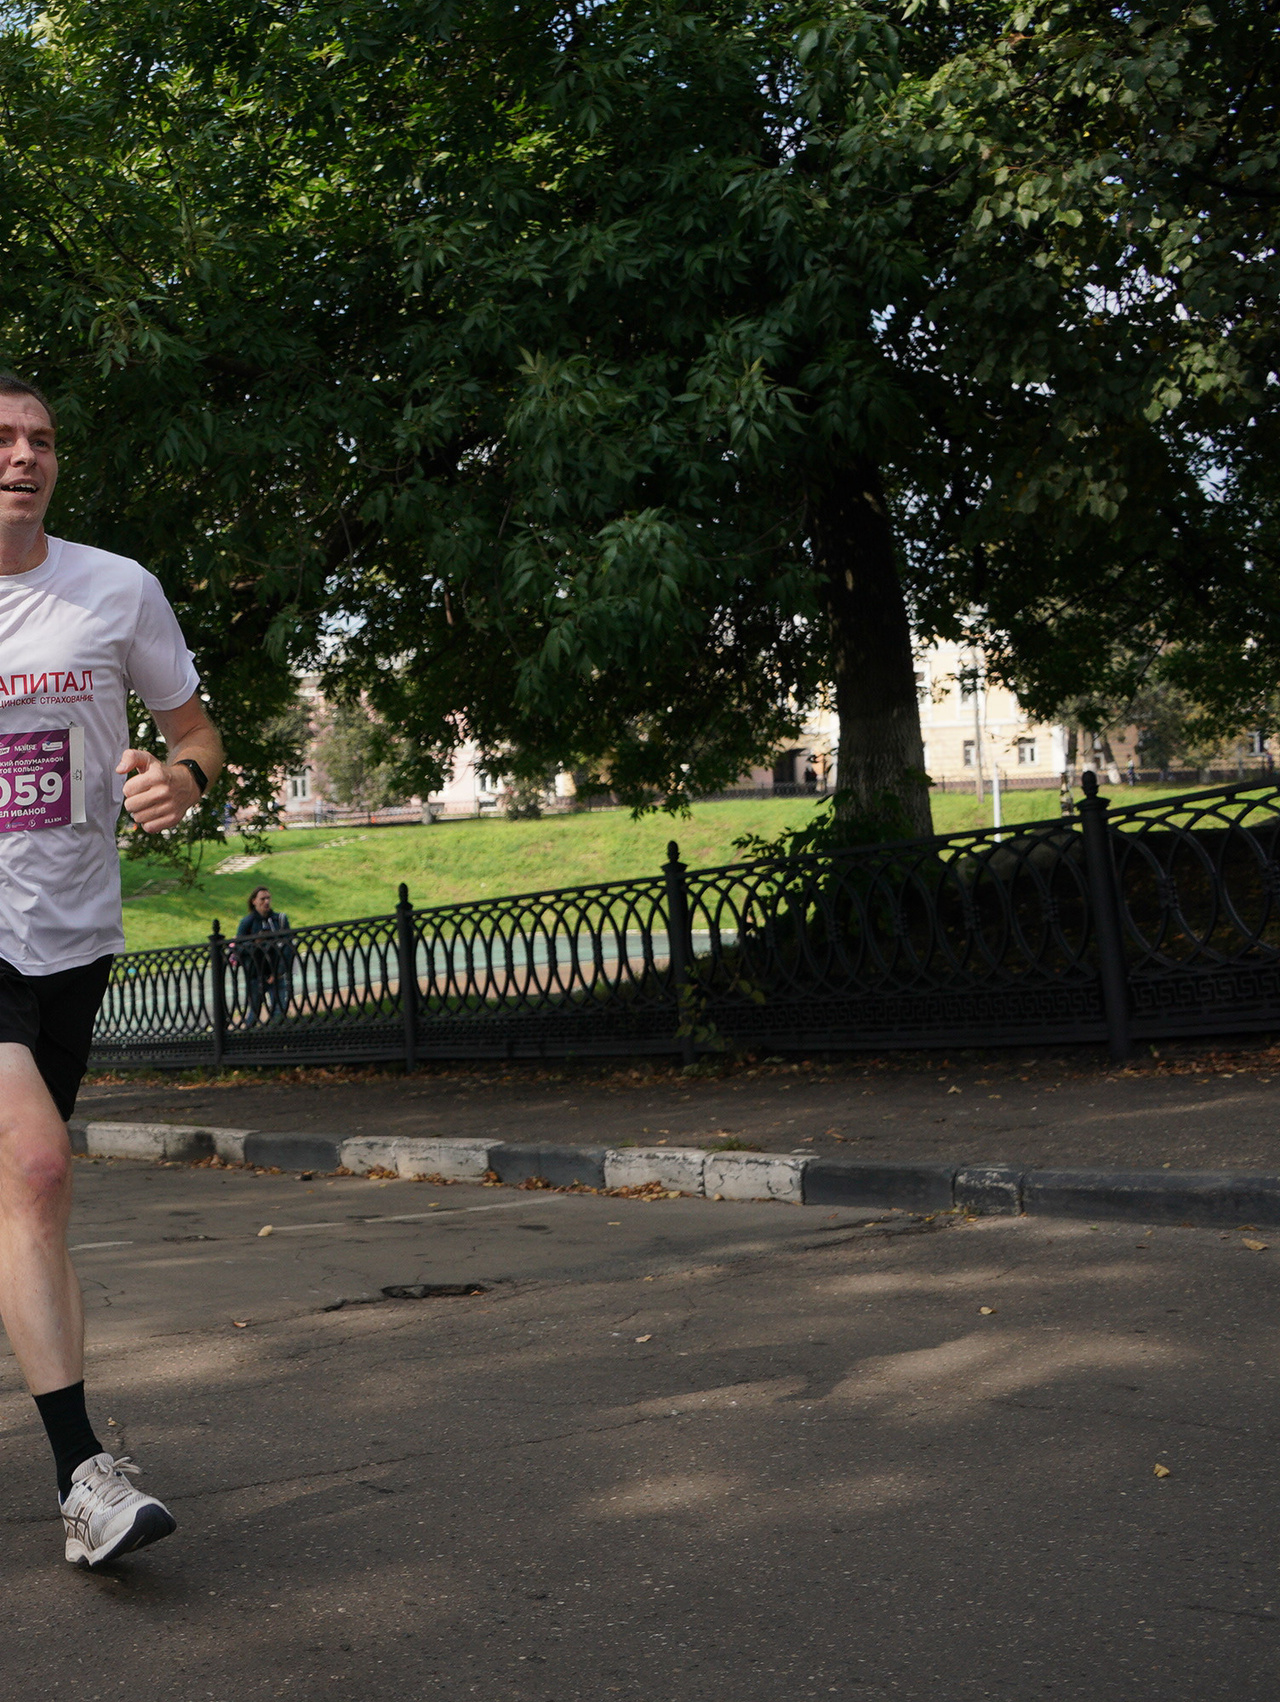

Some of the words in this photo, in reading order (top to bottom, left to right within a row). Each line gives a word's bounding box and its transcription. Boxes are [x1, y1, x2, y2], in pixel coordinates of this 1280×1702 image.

[40, 694, 94, 704] СТРАХОВАНИЕ
[14, 756, 64, 766] ПОЛУМАРАФОН
[13, 766, 44, 774] КОЛЬЦО»
[11, 807, 46, 817] ИВАНОВ
